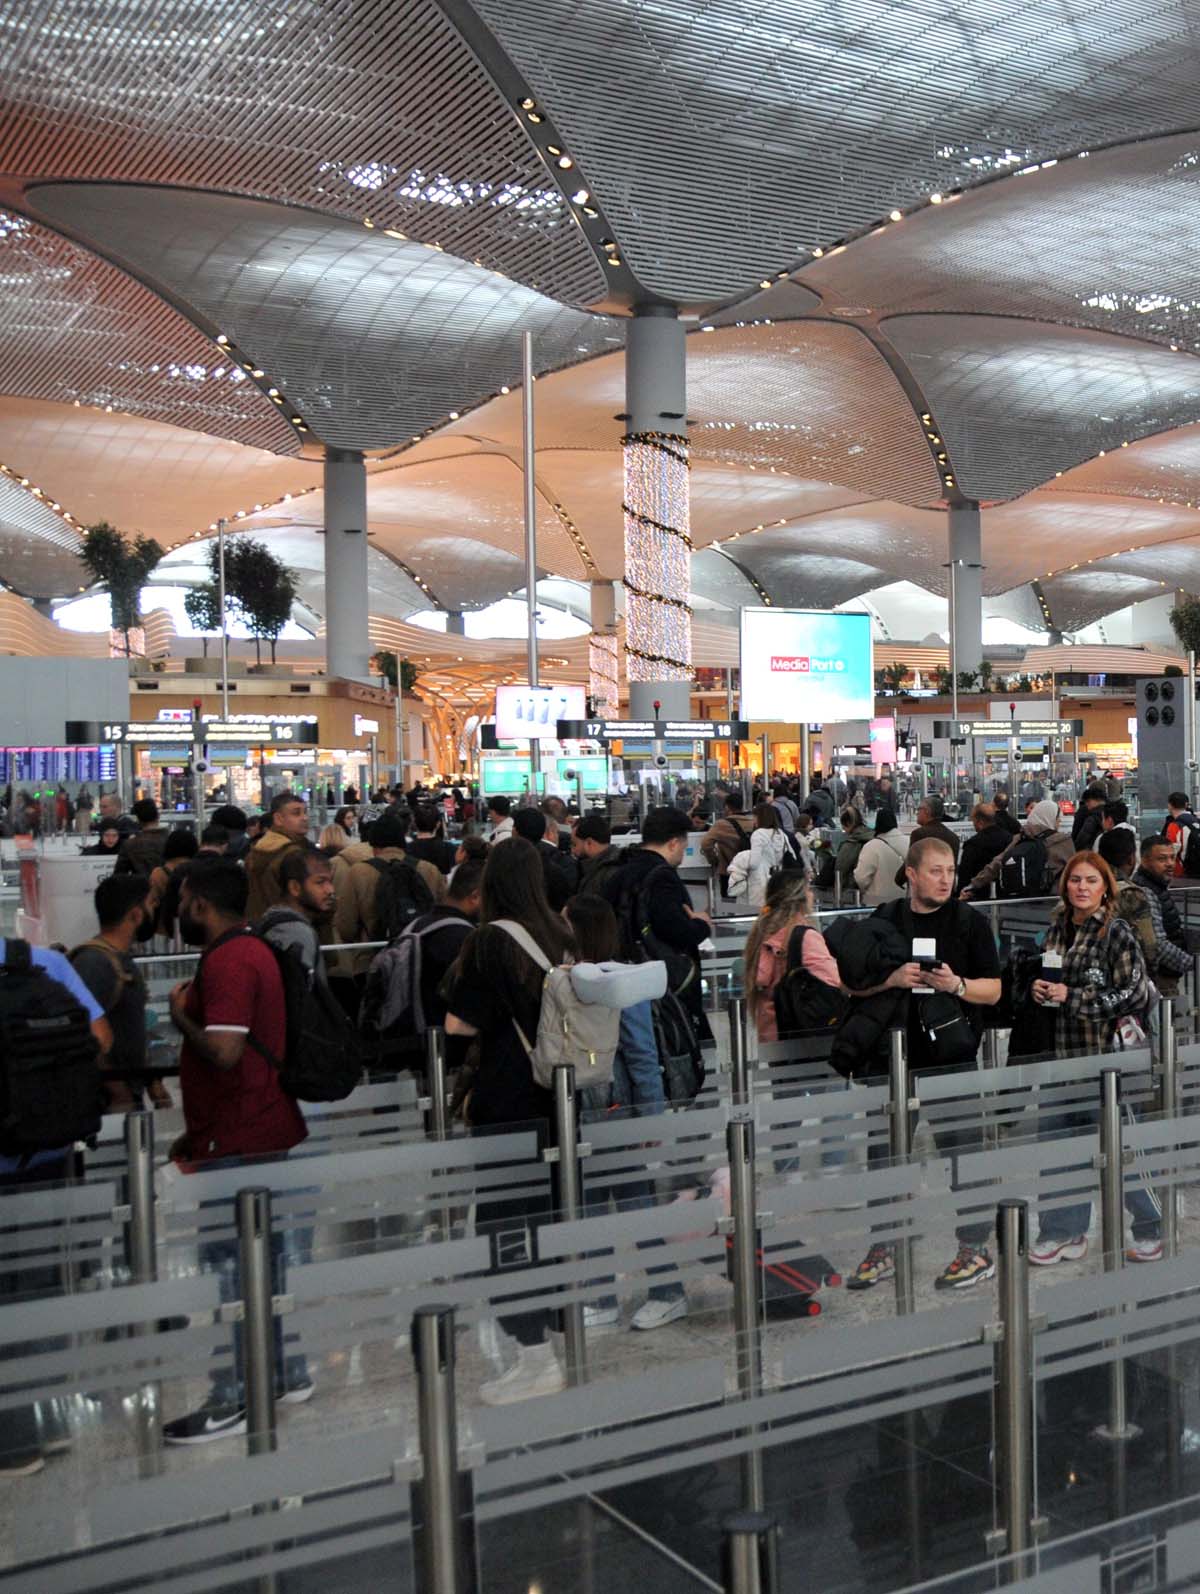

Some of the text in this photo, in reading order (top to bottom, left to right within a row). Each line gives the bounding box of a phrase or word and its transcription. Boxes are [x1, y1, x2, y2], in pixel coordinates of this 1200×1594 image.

[772, 658, 809, 671] Media
[103, 725, 123, 740] 15
[275, 726, 293, 740] 16
[587, 723, 601, 736] 17
[717, 724, 732, 737] 18
[959, 724, 971, 734] 19
[1060, 723, 1072, 734] 20
